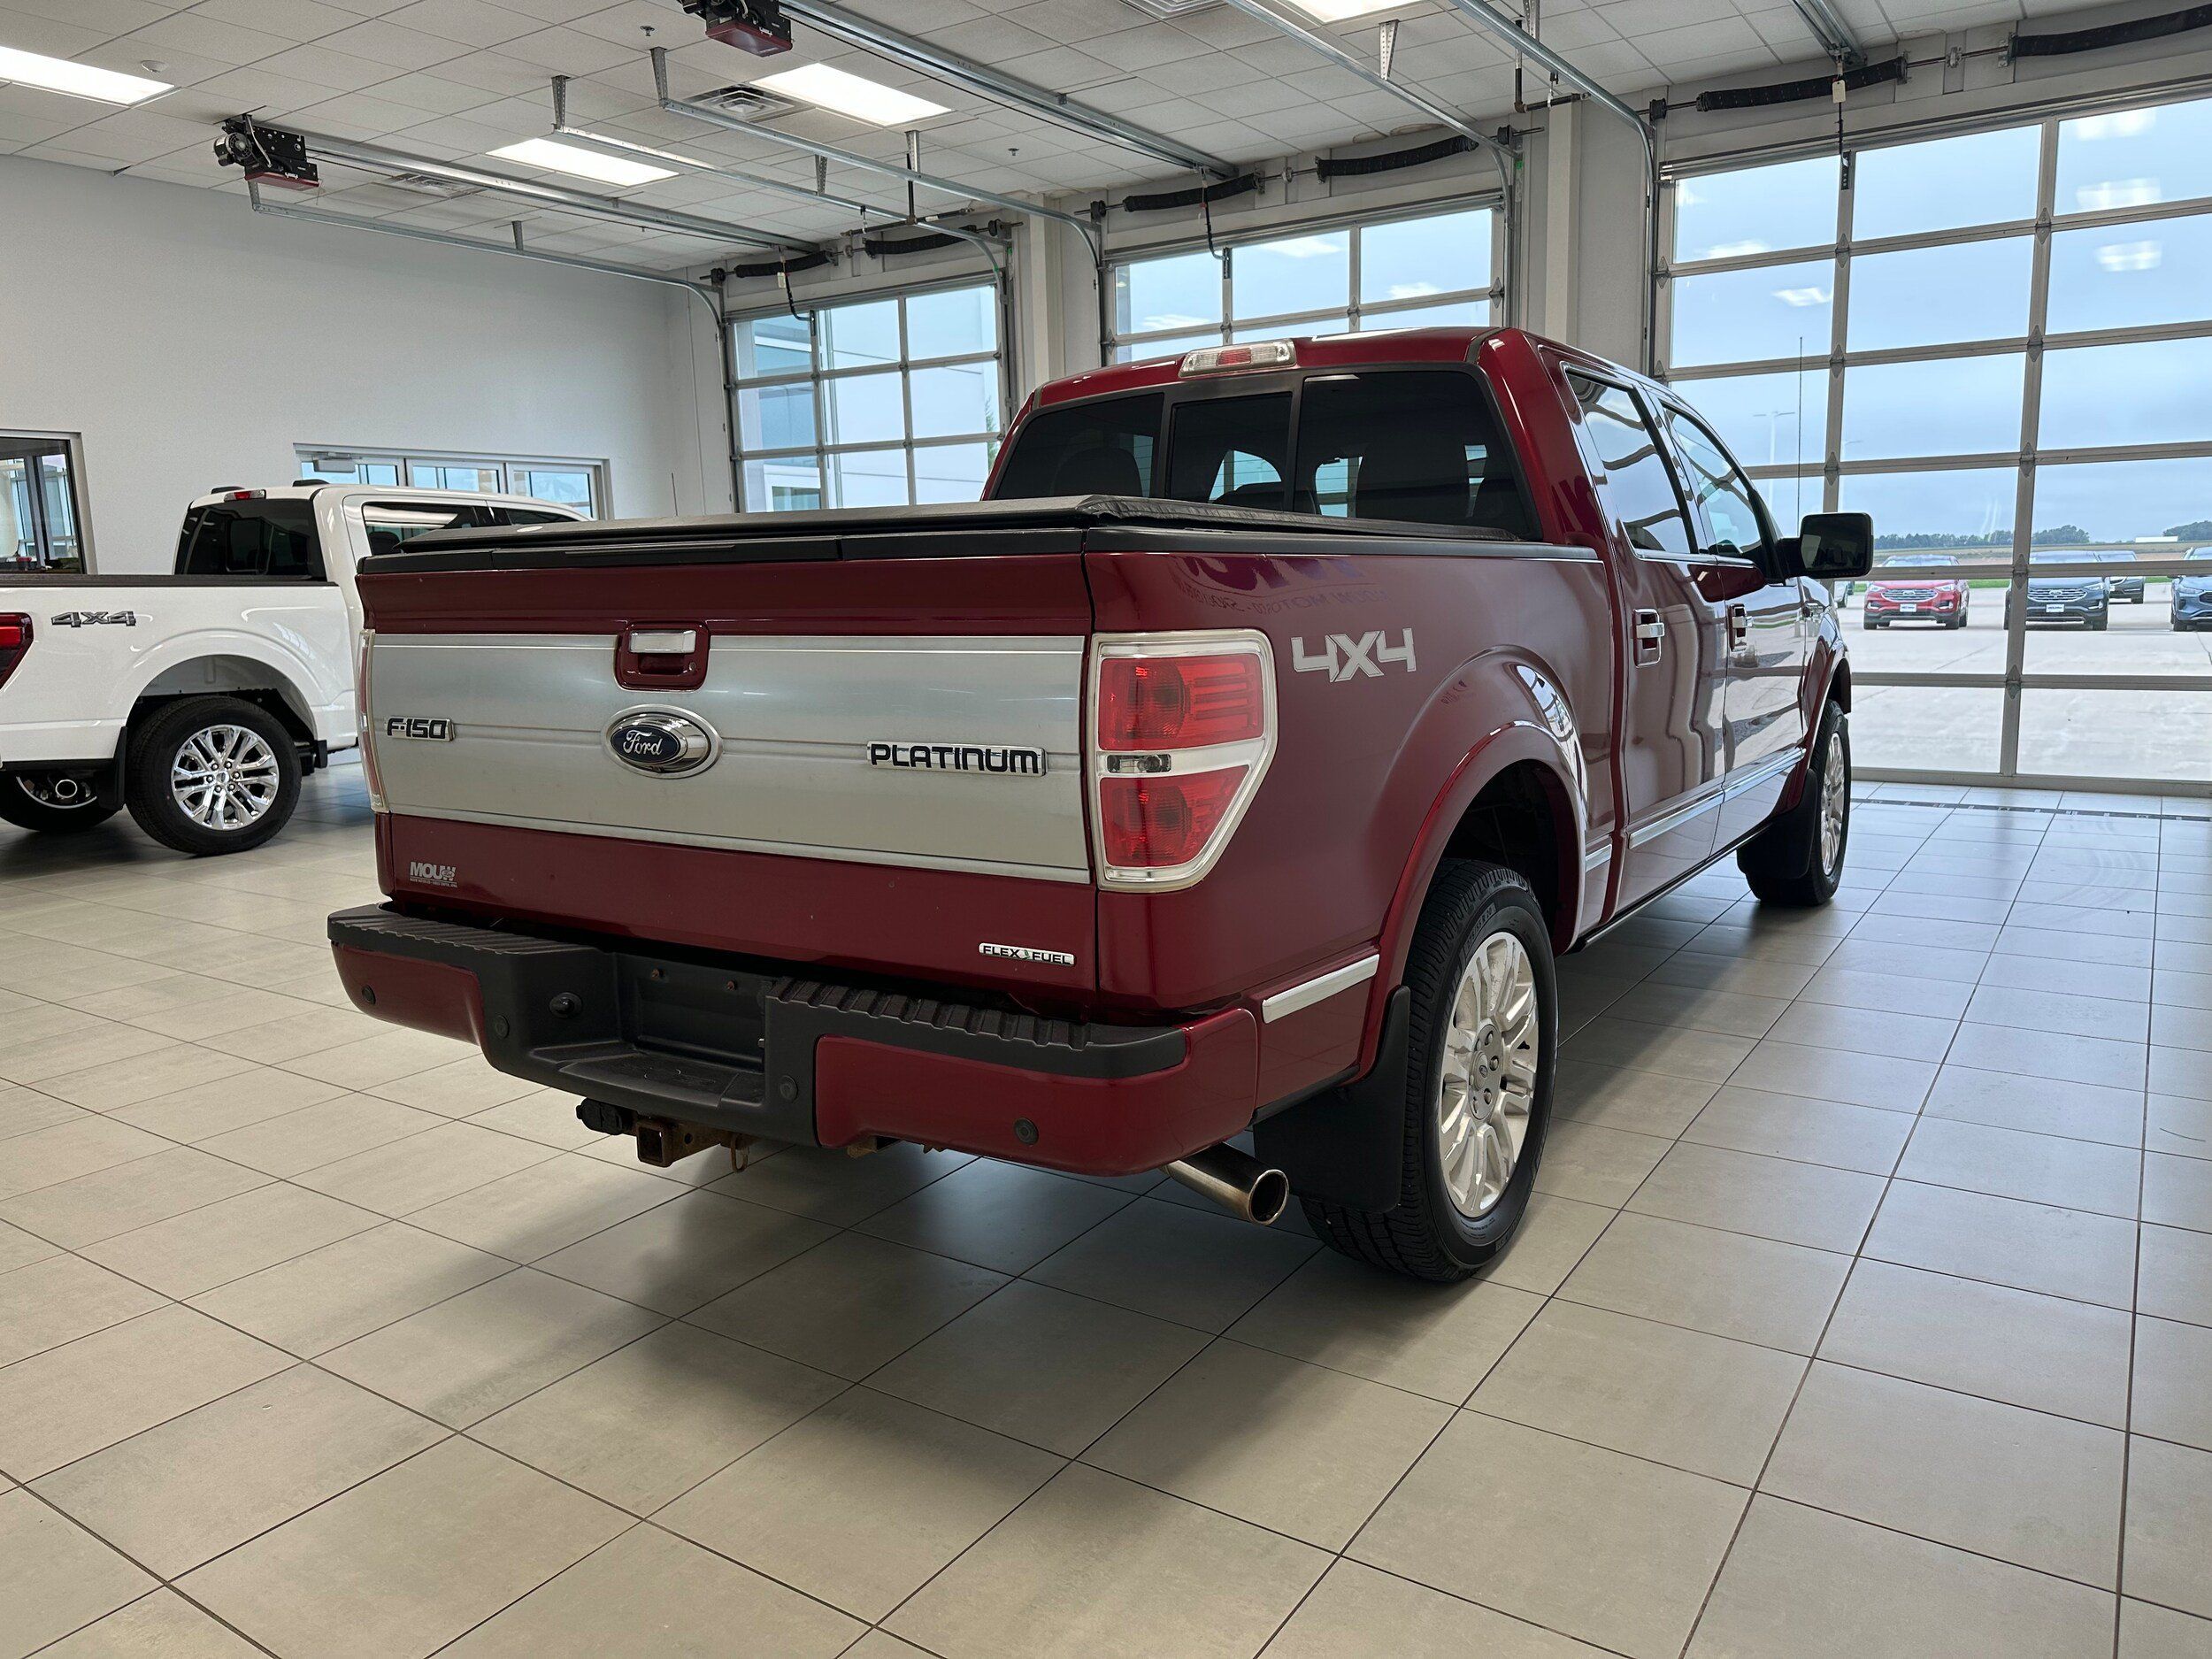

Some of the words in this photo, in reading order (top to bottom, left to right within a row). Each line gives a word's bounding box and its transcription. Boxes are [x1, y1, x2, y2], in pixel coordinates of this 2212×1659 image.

[1290, 626, 1417, 683] 4X4
[387, 718, 448, 740] F-150
[622, 729, 664, 756] Ford
[870, 743, 1040, 774] PLATINUM
[982, 945, 1020, 959] FLEX
[1032, 951, 1071, 965] FUEL
